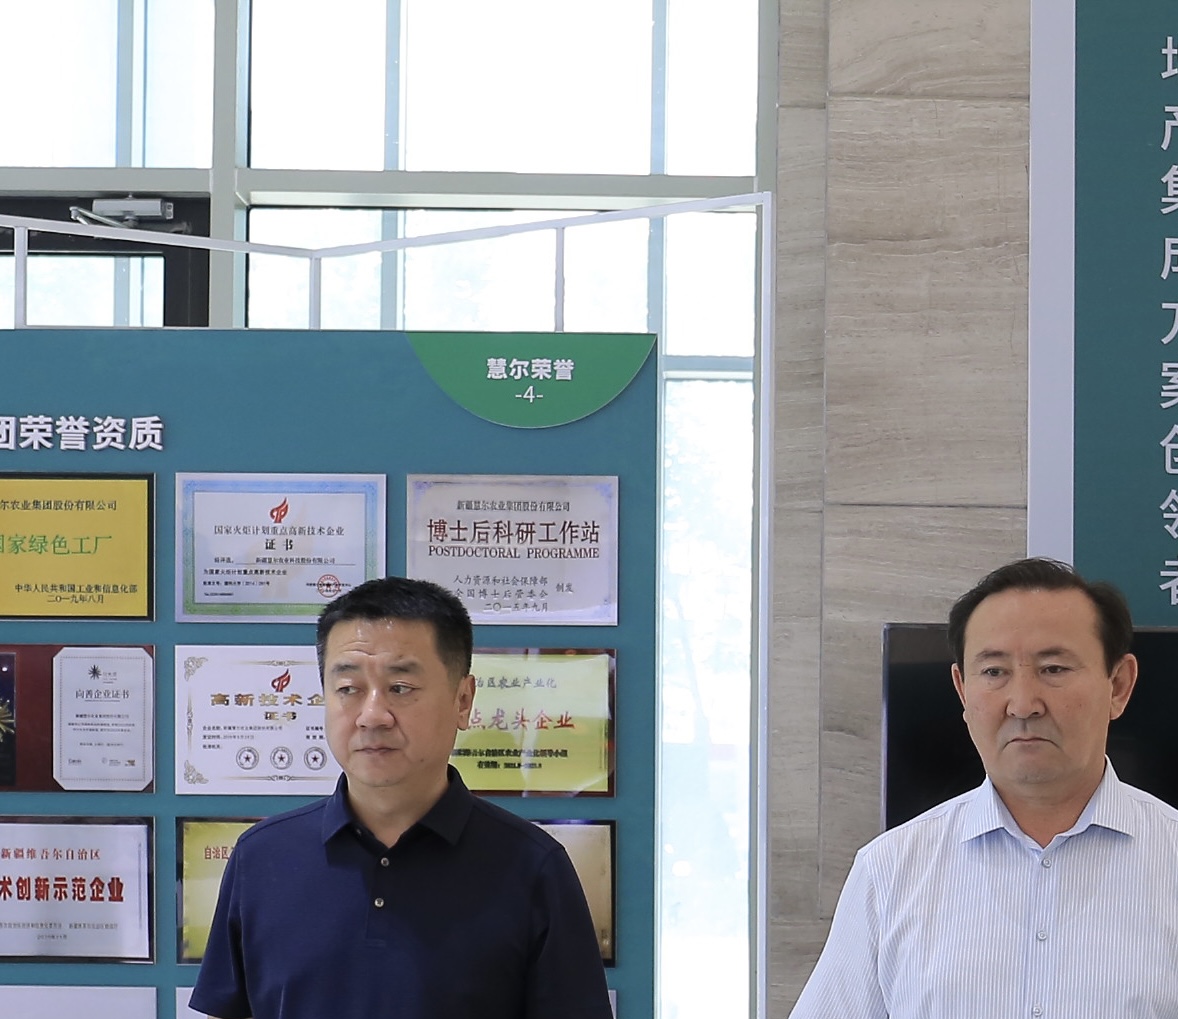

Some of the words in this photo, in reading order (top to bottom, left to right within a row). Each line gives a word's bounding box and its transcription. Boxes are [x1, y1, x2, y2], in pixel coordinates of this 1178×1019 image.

[487, 358, 574, 381] 慧尔荣誉
[214, 525, 345, 536] 国家火炬计划重点高新技术企业
[427, 519, 600, 544] 博士后科研工作站
[0, 534, 113, 556] 家绿色工厂
[265, 538, 294, 551] 证书
[428, 545, 520, 558] POSTDOCTORAL
[527, 548, 600, 559] PROGRAMME
[453, 575, 548, 586] 人力资源和社会保障部
[75, 689, 130, 699] 向善企业证书
[1, 848, 101, 860] 新疆维吾尔自治区
[205, 845, 234, 860] 自治区
[0, 876, 124, 902] 术创新示范企业
